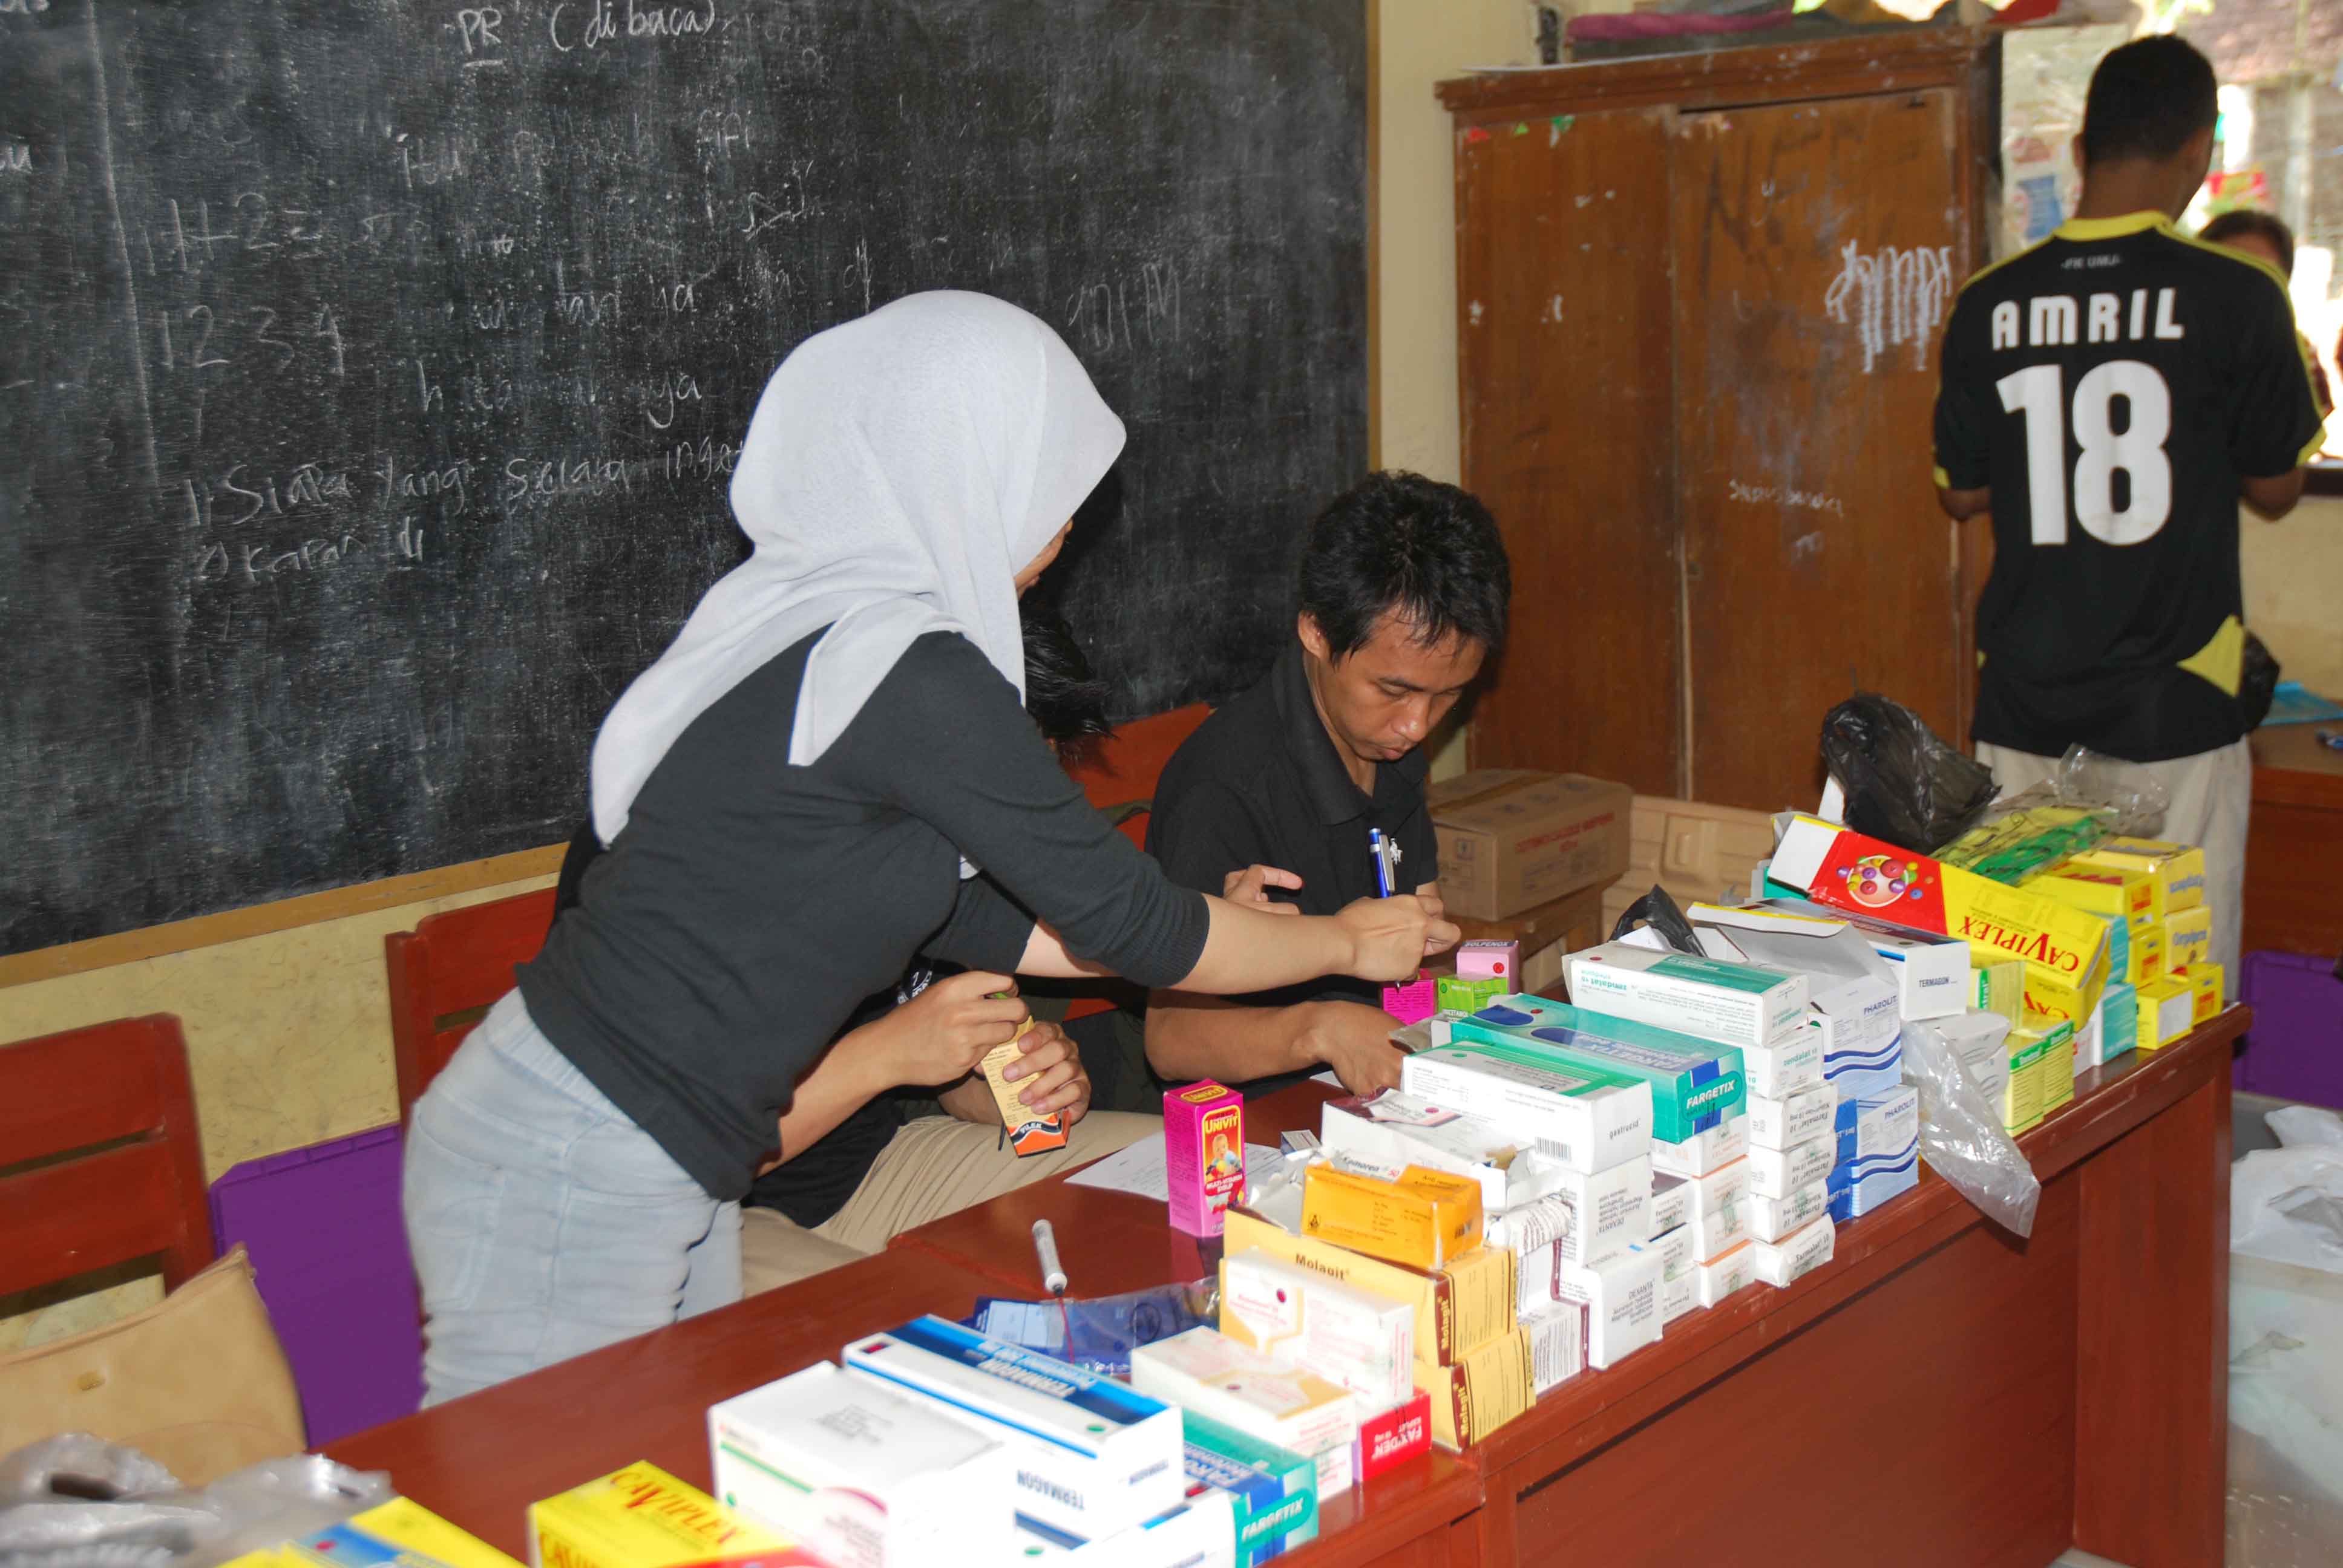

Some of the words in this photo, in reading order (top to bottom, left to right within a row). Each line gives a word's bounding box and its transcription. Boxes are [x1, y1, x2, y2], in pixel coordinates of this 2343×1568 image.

[1992, 288, 2184, 351] AMRIL
[1996, 359, 2172, 546] 18
[1958, 915, 2080, 973] CAVIPLEX
[1686, 1079, 1737, 1109] FARGETIX
[1205, 1115, 1239, 1133] UNIVIT
[1295, 1253, 1346, 1281] Molagit
[1441, 1298, 1452, 1351] Molagit
[1456, 1386, 1471, 1437] Molagit
[1017, 1469, 1086, 1511] TERMAGON
[1241, 1497, 1304, 1540] FARGETIX
